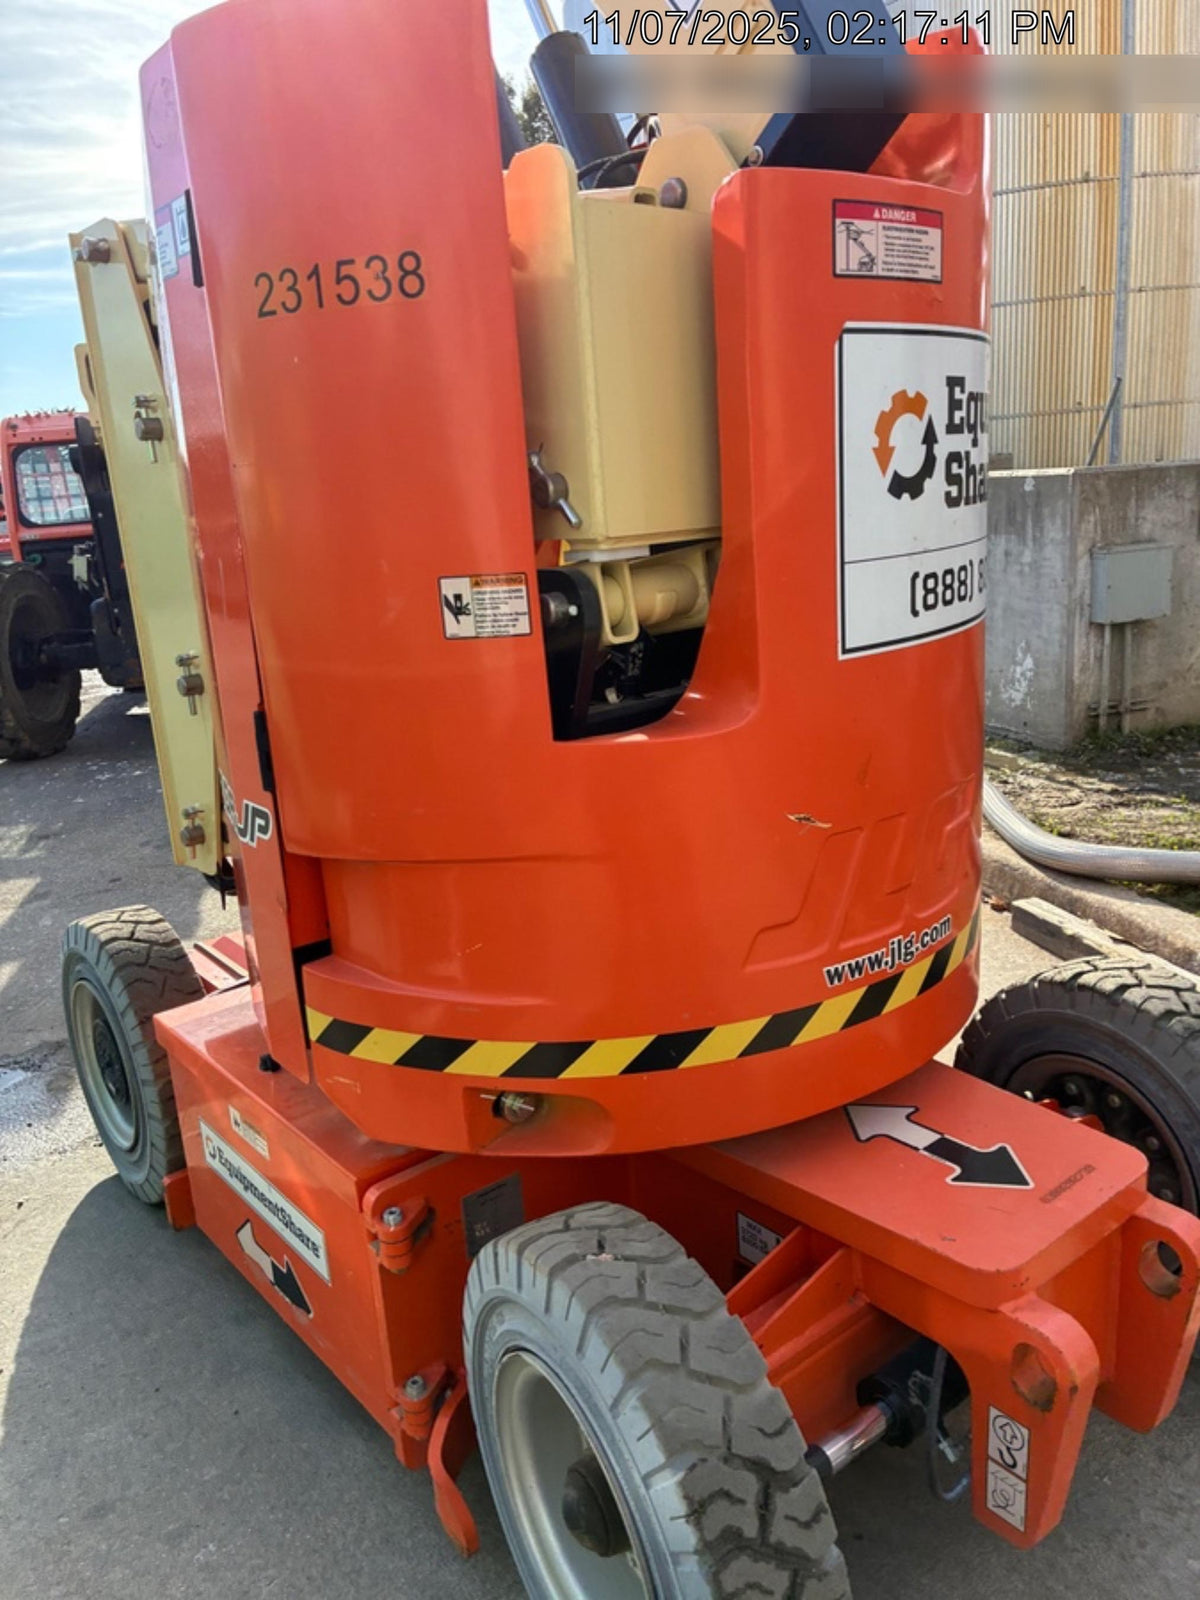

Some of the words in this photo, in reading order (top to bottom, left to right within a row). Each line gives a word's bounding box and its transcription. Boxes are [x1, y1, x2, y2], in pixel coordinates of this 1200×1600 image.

[881, 208, 917, 222] DANGER
[254, 250, 426, 319] 231538
[910, 559, 974, 618] (888)
[824, 915, 952, 988] www.jlg.com
[216, 1147, 321, 1259] EquipmentShare
